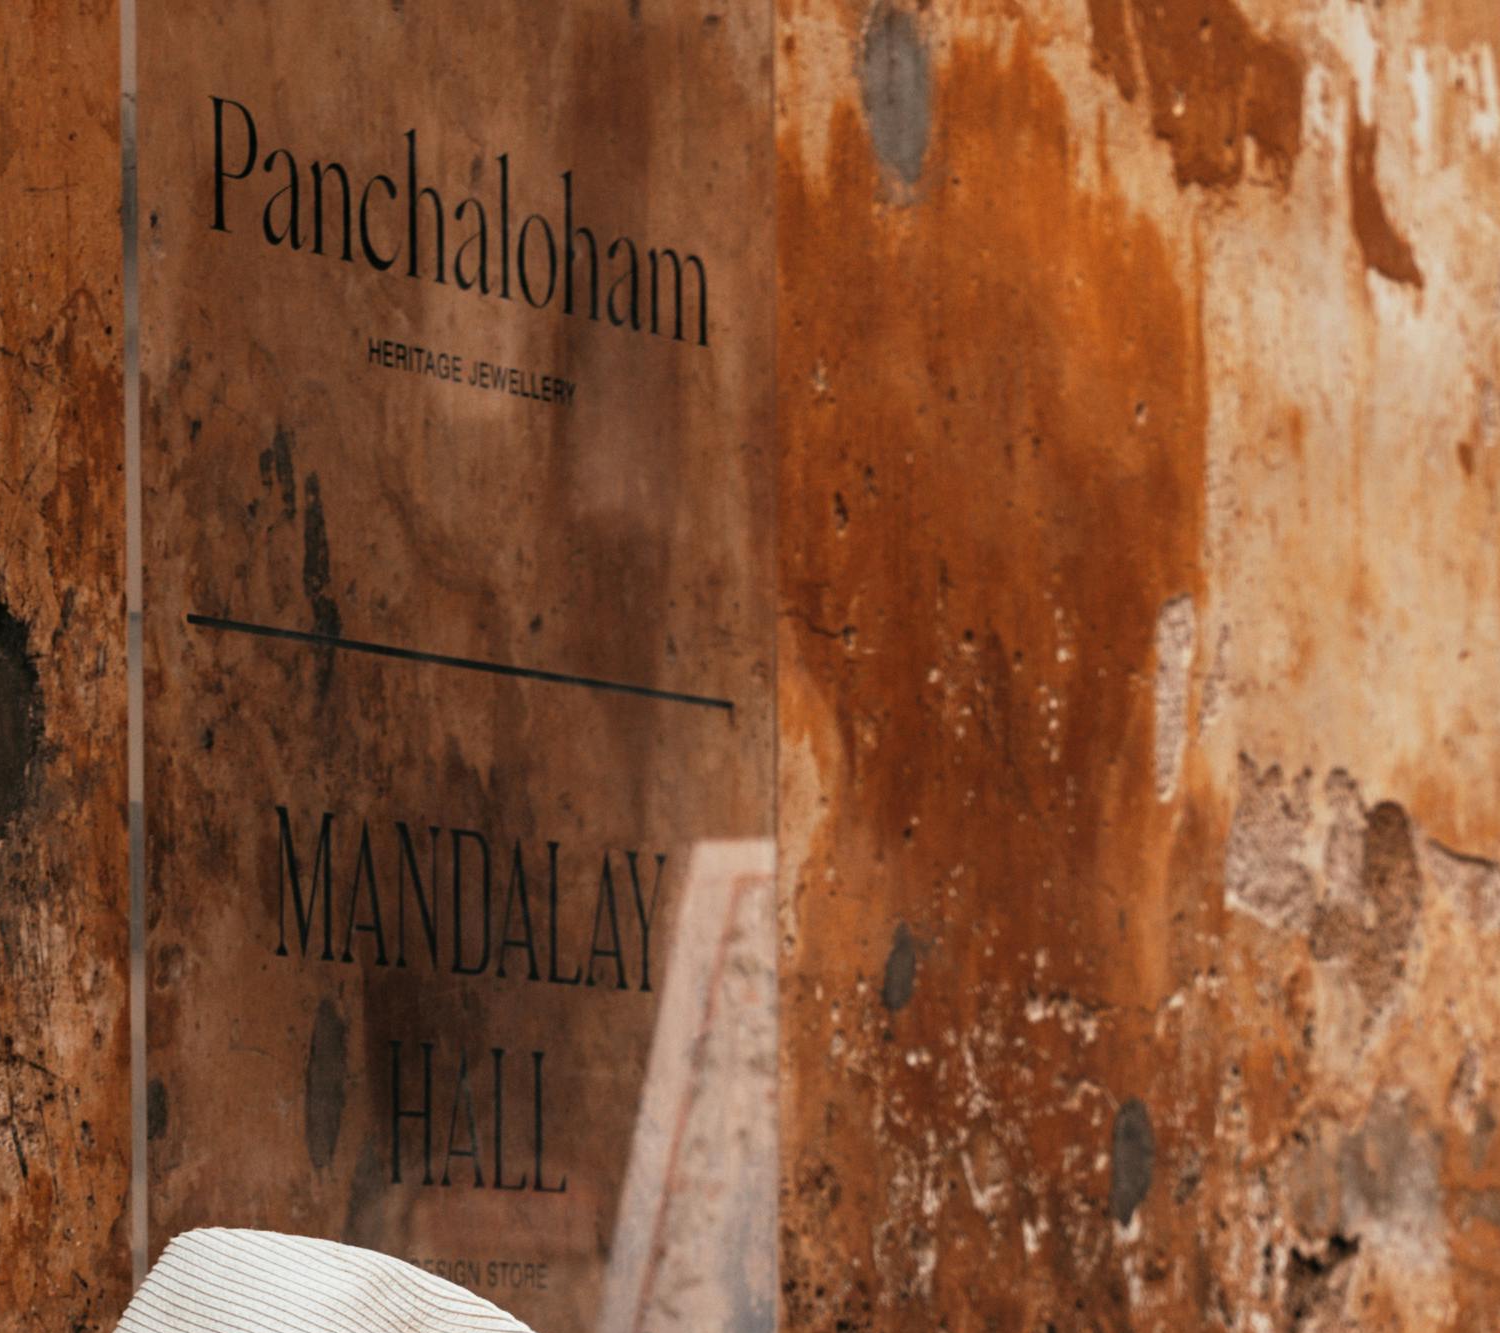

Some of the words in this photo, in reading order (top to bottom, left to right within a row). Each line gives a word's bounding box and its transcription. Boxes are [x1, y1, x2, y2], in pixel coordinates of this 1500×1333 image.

[208, 95, 709, 347] Panchaloham
[368, 337, 462, 383] HERITAGE
[469, 360, 577, 405] JEWELLERY
[274, 806, 667, 992] MANDALAY
[390, 1039, 567, 1194] HALL
[409, 1259, 481, 1287] ESIGN
[487, 1260, 549, 1289] STORE
